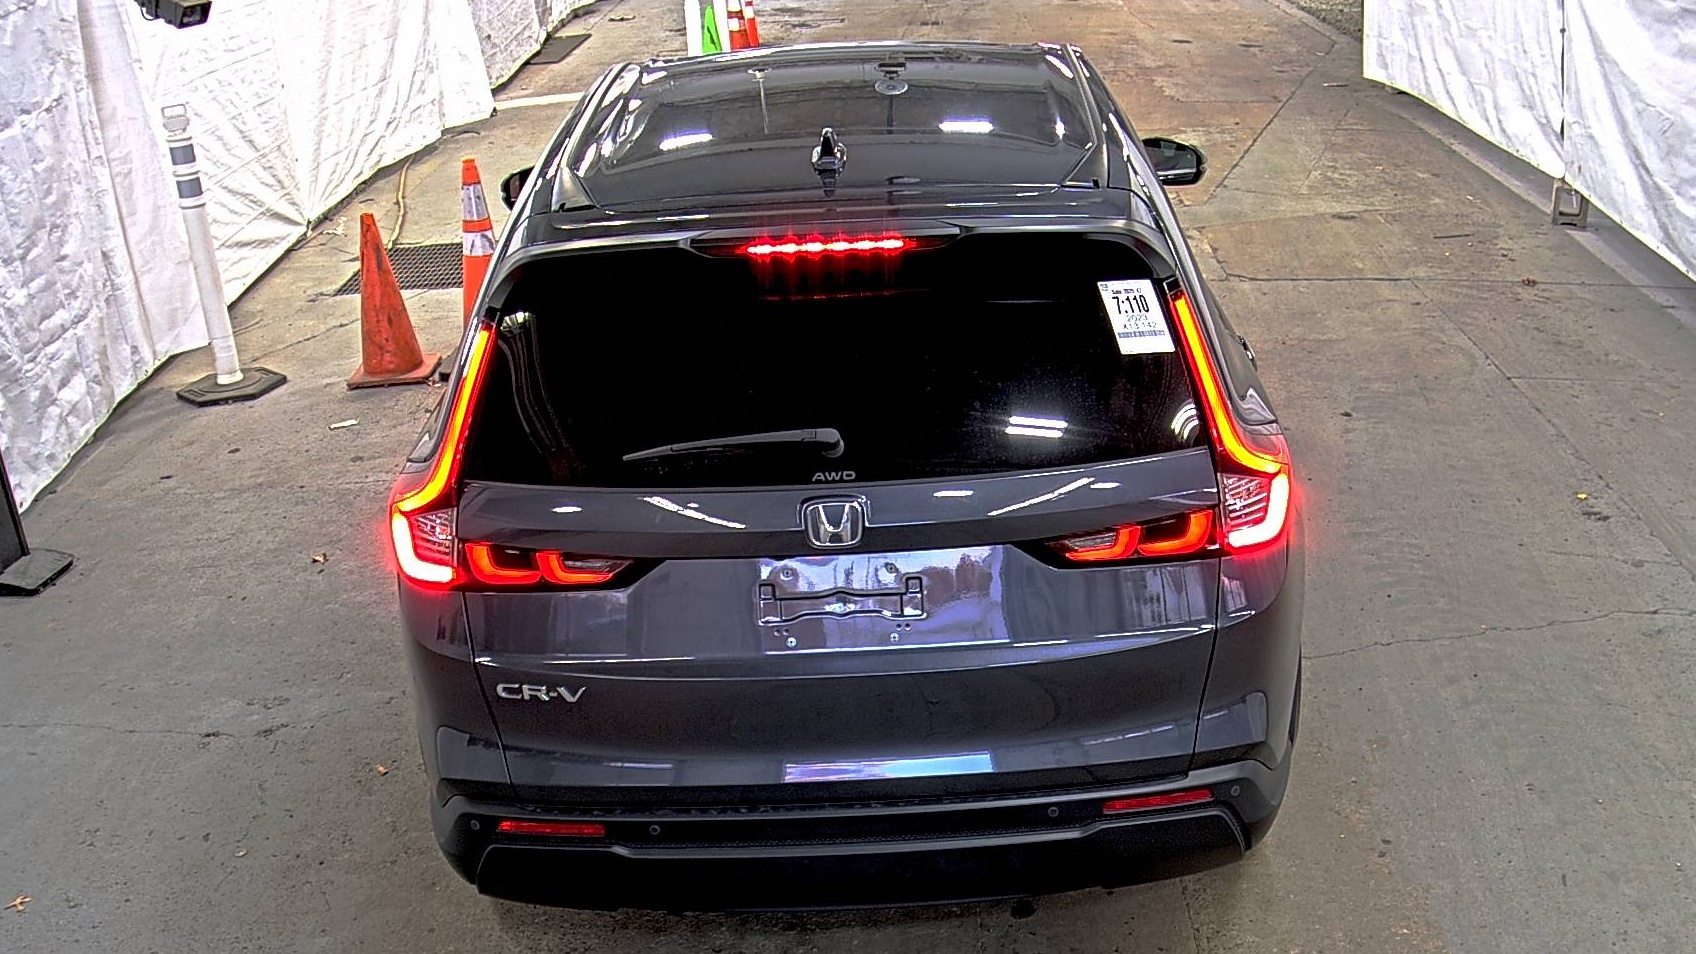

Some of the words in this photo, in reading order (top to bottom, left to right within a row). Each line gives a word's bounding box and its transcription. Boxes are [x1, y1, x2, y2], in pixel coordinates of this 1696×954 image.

[1111, 294, 1149, 315] 7:110
[812, 470, 856, 482] AWD
[495, 682, 587, 703] CR-V
